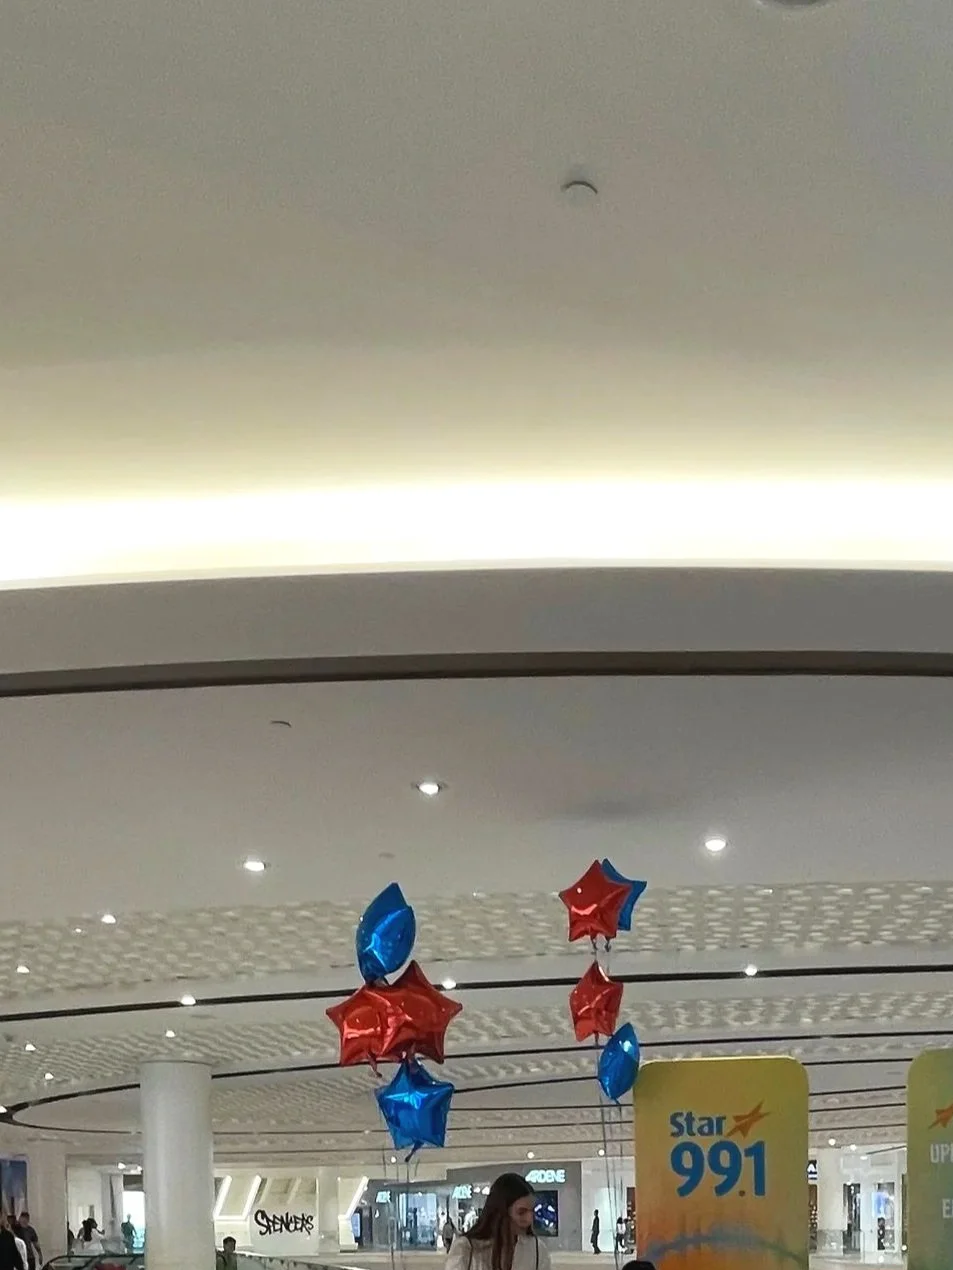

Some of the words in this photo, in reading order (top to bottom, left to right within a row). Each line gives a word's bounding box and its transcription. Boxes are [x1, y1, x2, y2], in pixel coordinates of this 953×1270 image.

[670, 1111, 726, 1137] Star
[525, 1169, 565, 1183] ARDENE
[671, 1140, 766, 1197] 99.1
